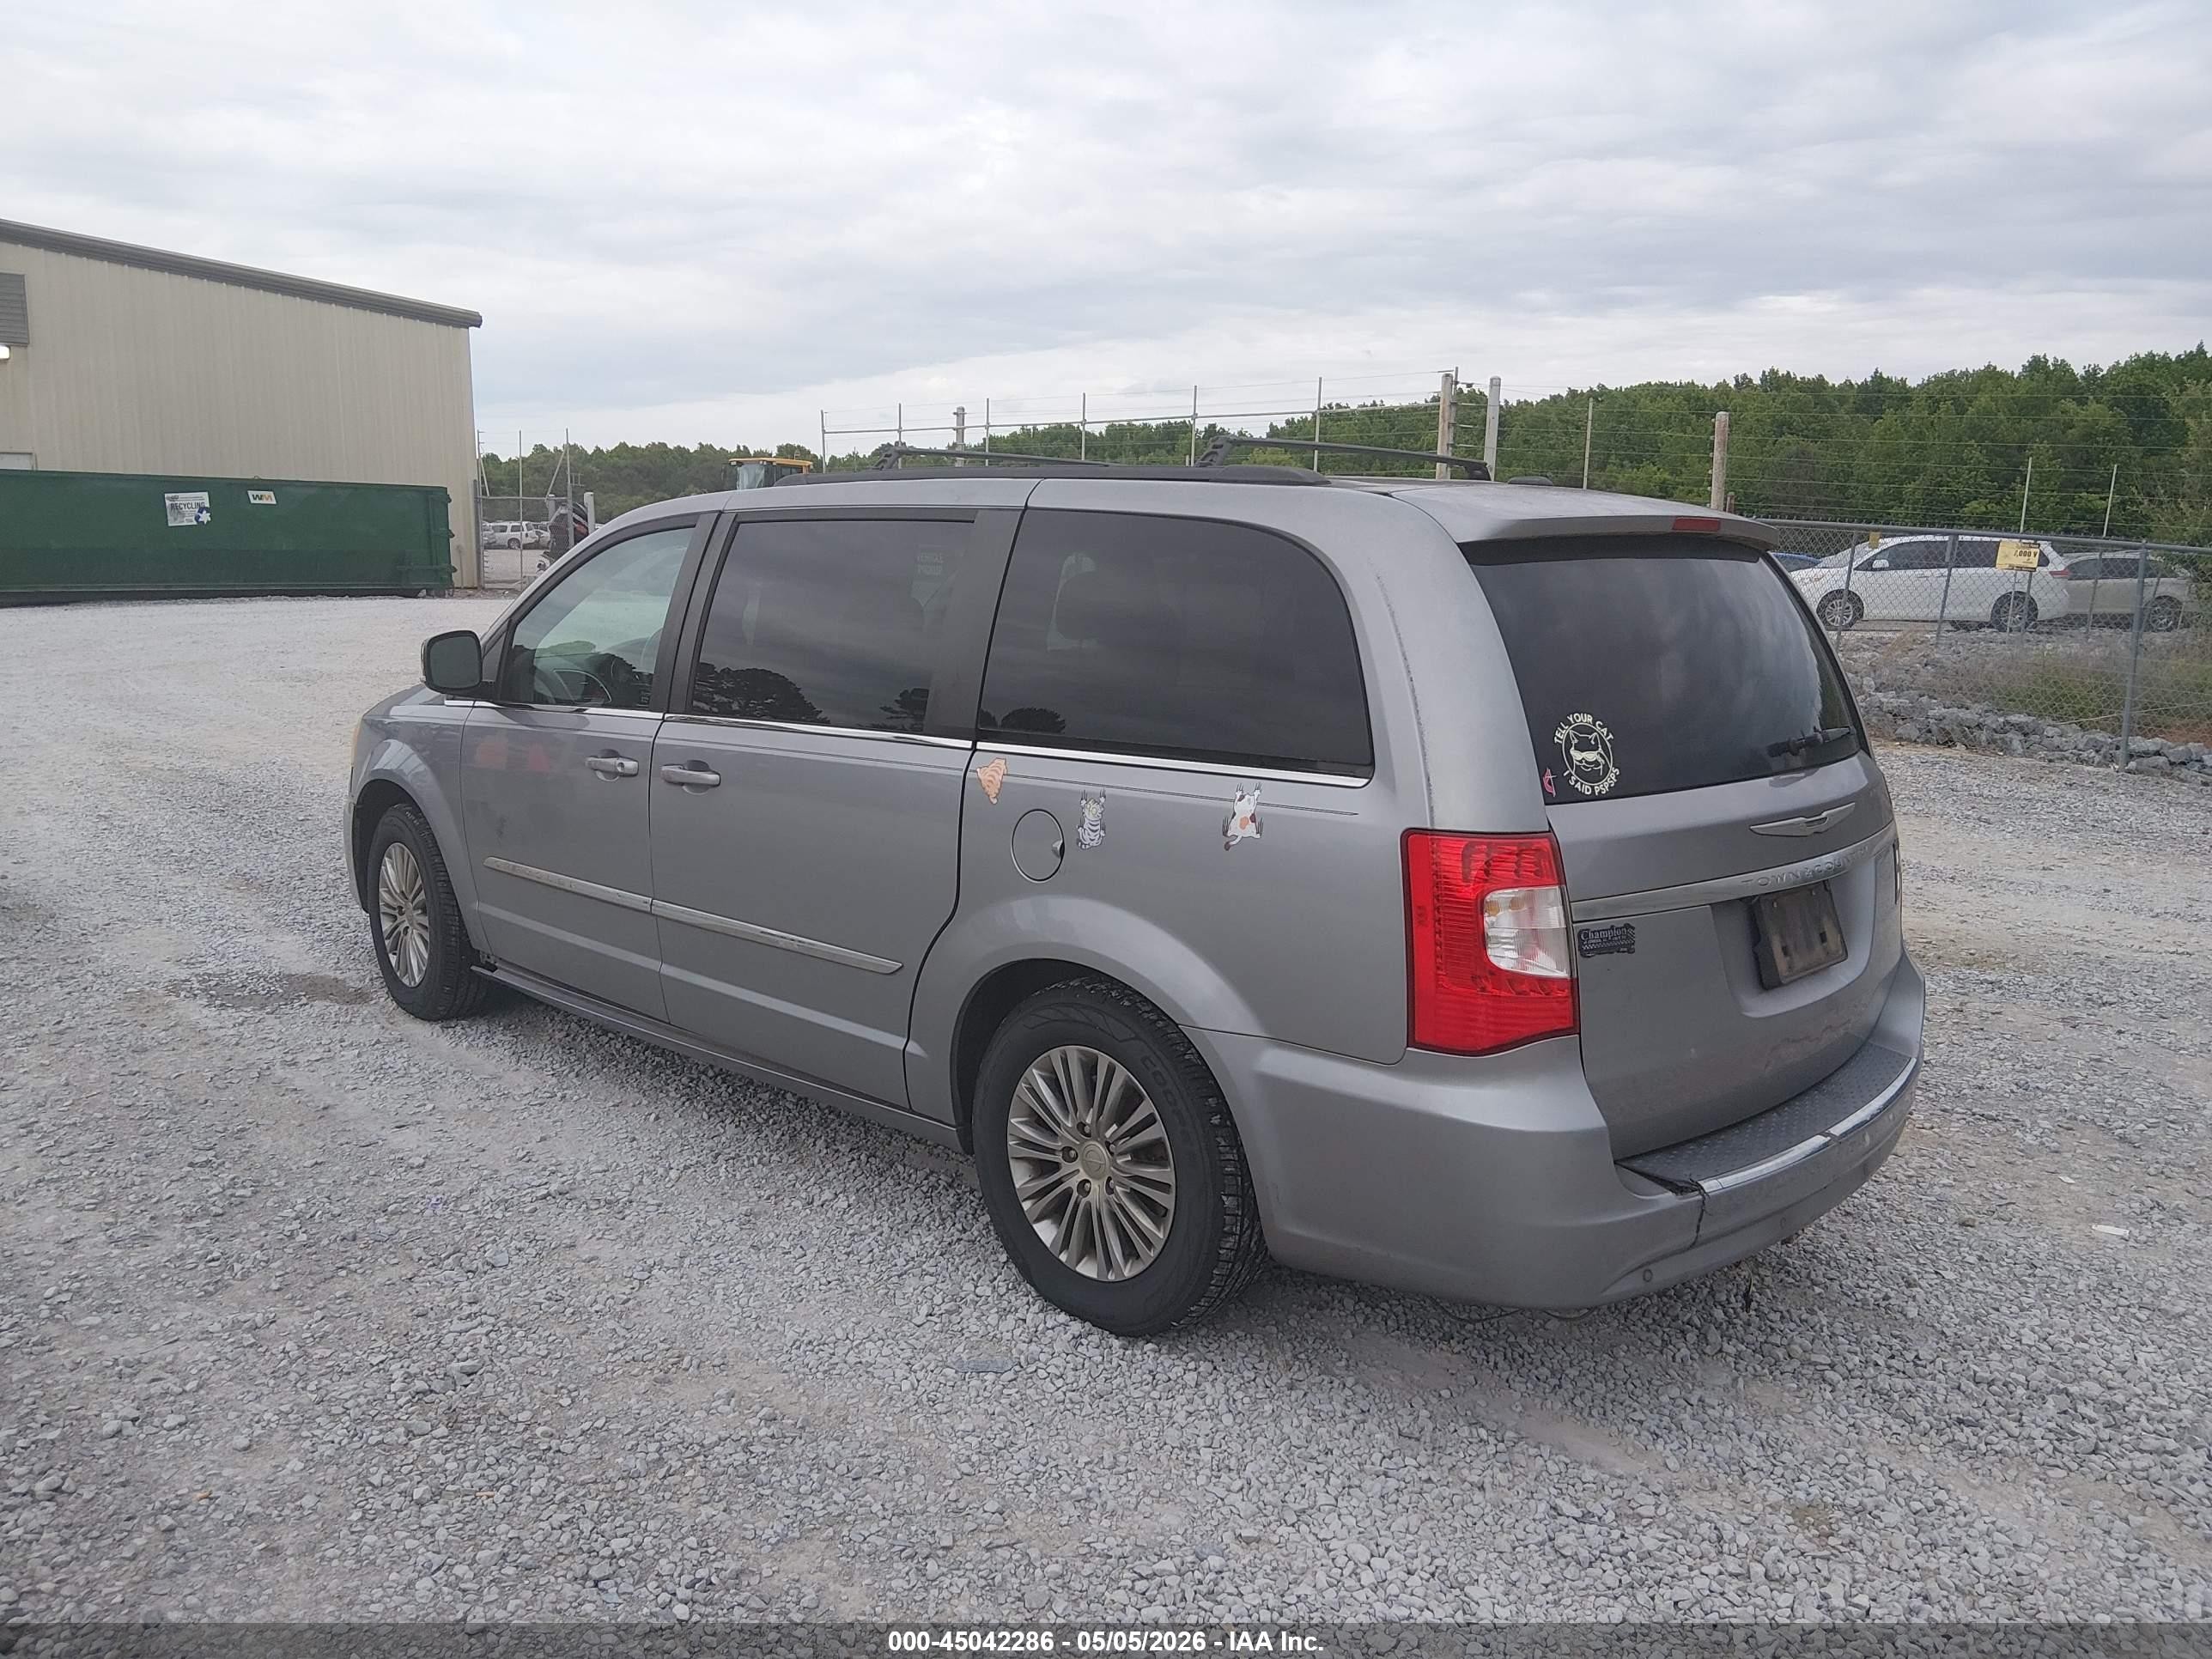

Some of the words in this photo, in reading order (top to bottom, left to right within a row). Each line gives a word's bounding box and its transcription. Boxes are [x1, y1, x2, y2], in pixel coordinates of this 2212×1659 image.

[170, 501, 205, 510] RECYCLING
[1553, 721, 1569, 744] TELL
[1566, 713, 1594, 725] YOUR
[1595, 720, 1614, 741] CAT
[1568, 775, 1592, 795] SAID
[1594, 767, 1620, 796] PSPSPS
